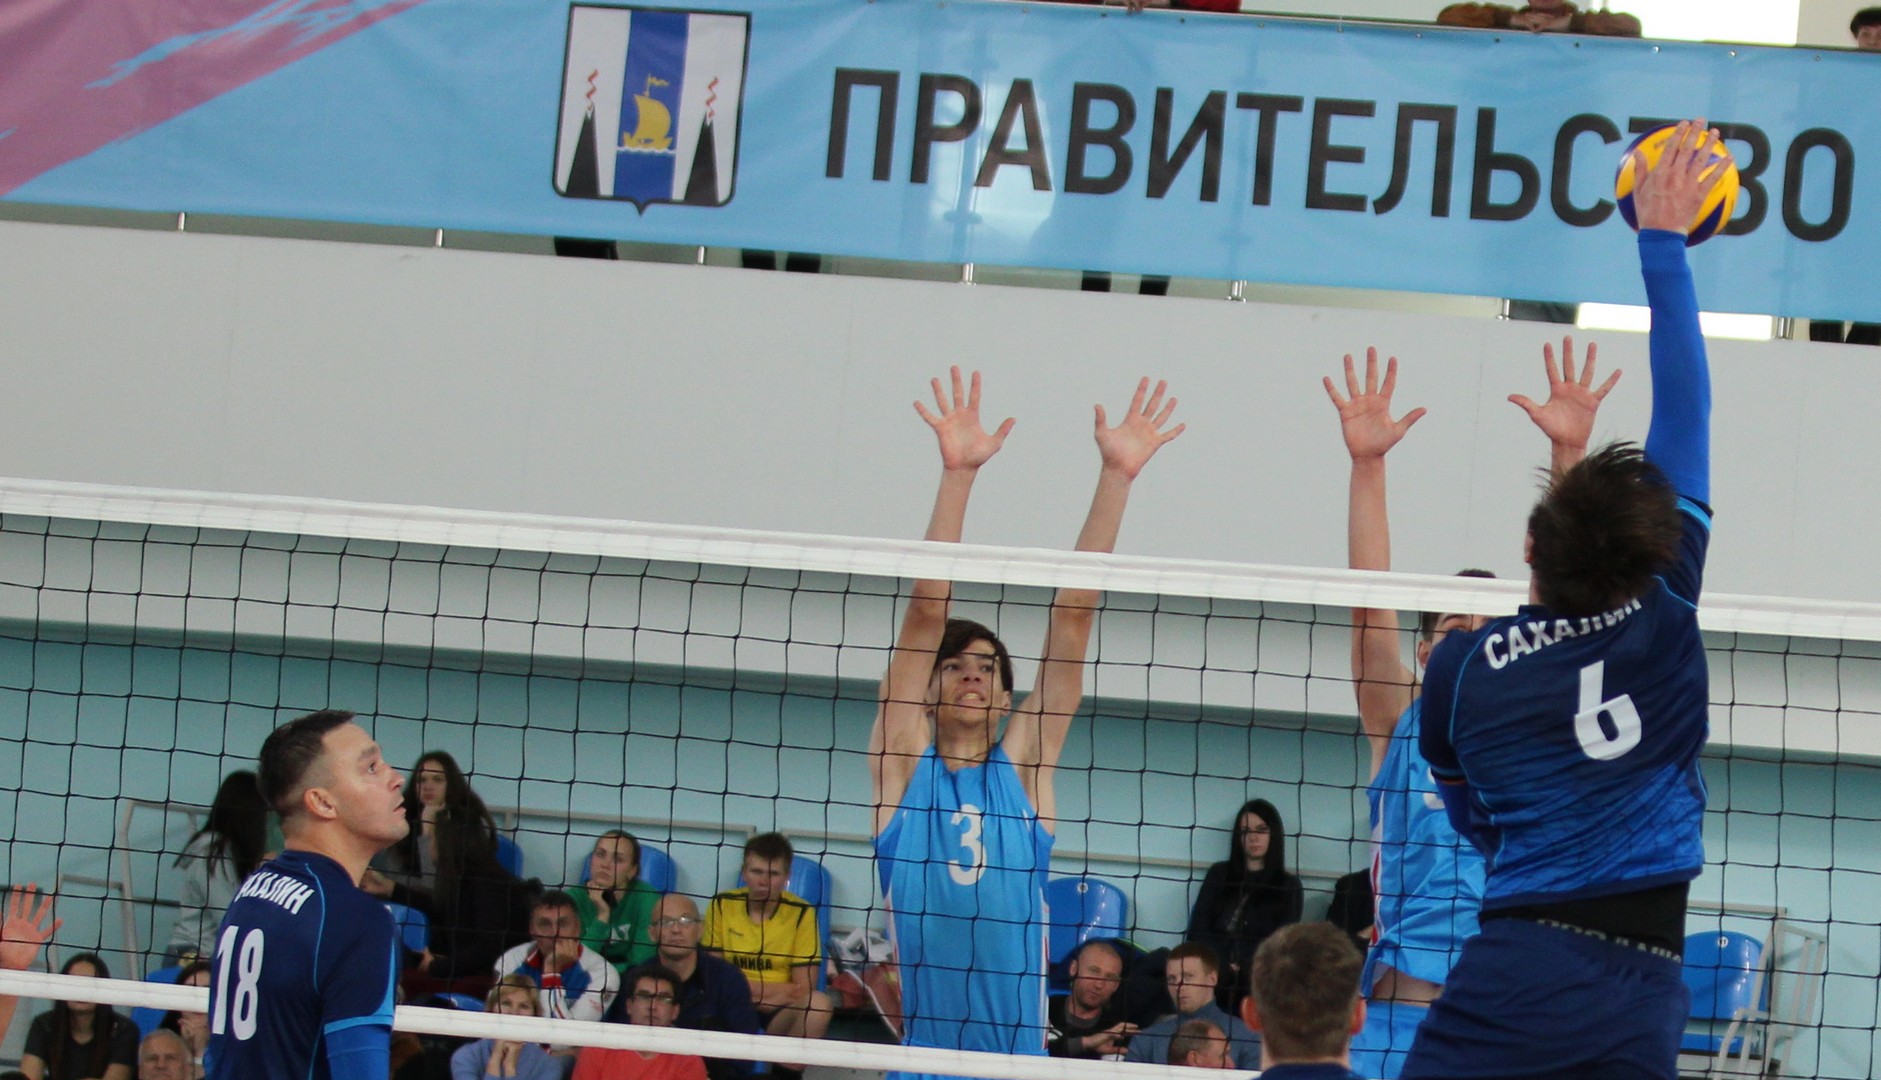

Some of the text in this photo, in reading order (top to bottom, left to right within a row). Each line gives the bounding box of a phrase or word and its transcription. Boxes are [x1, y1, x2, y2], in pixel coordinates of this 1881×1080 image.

[1574, 660, 1642, 761] 6
[948, 803, 988, 886] 3
[234, 871, 315, 915] АХАЛИН
[211, 925, 265, 1041] 18
